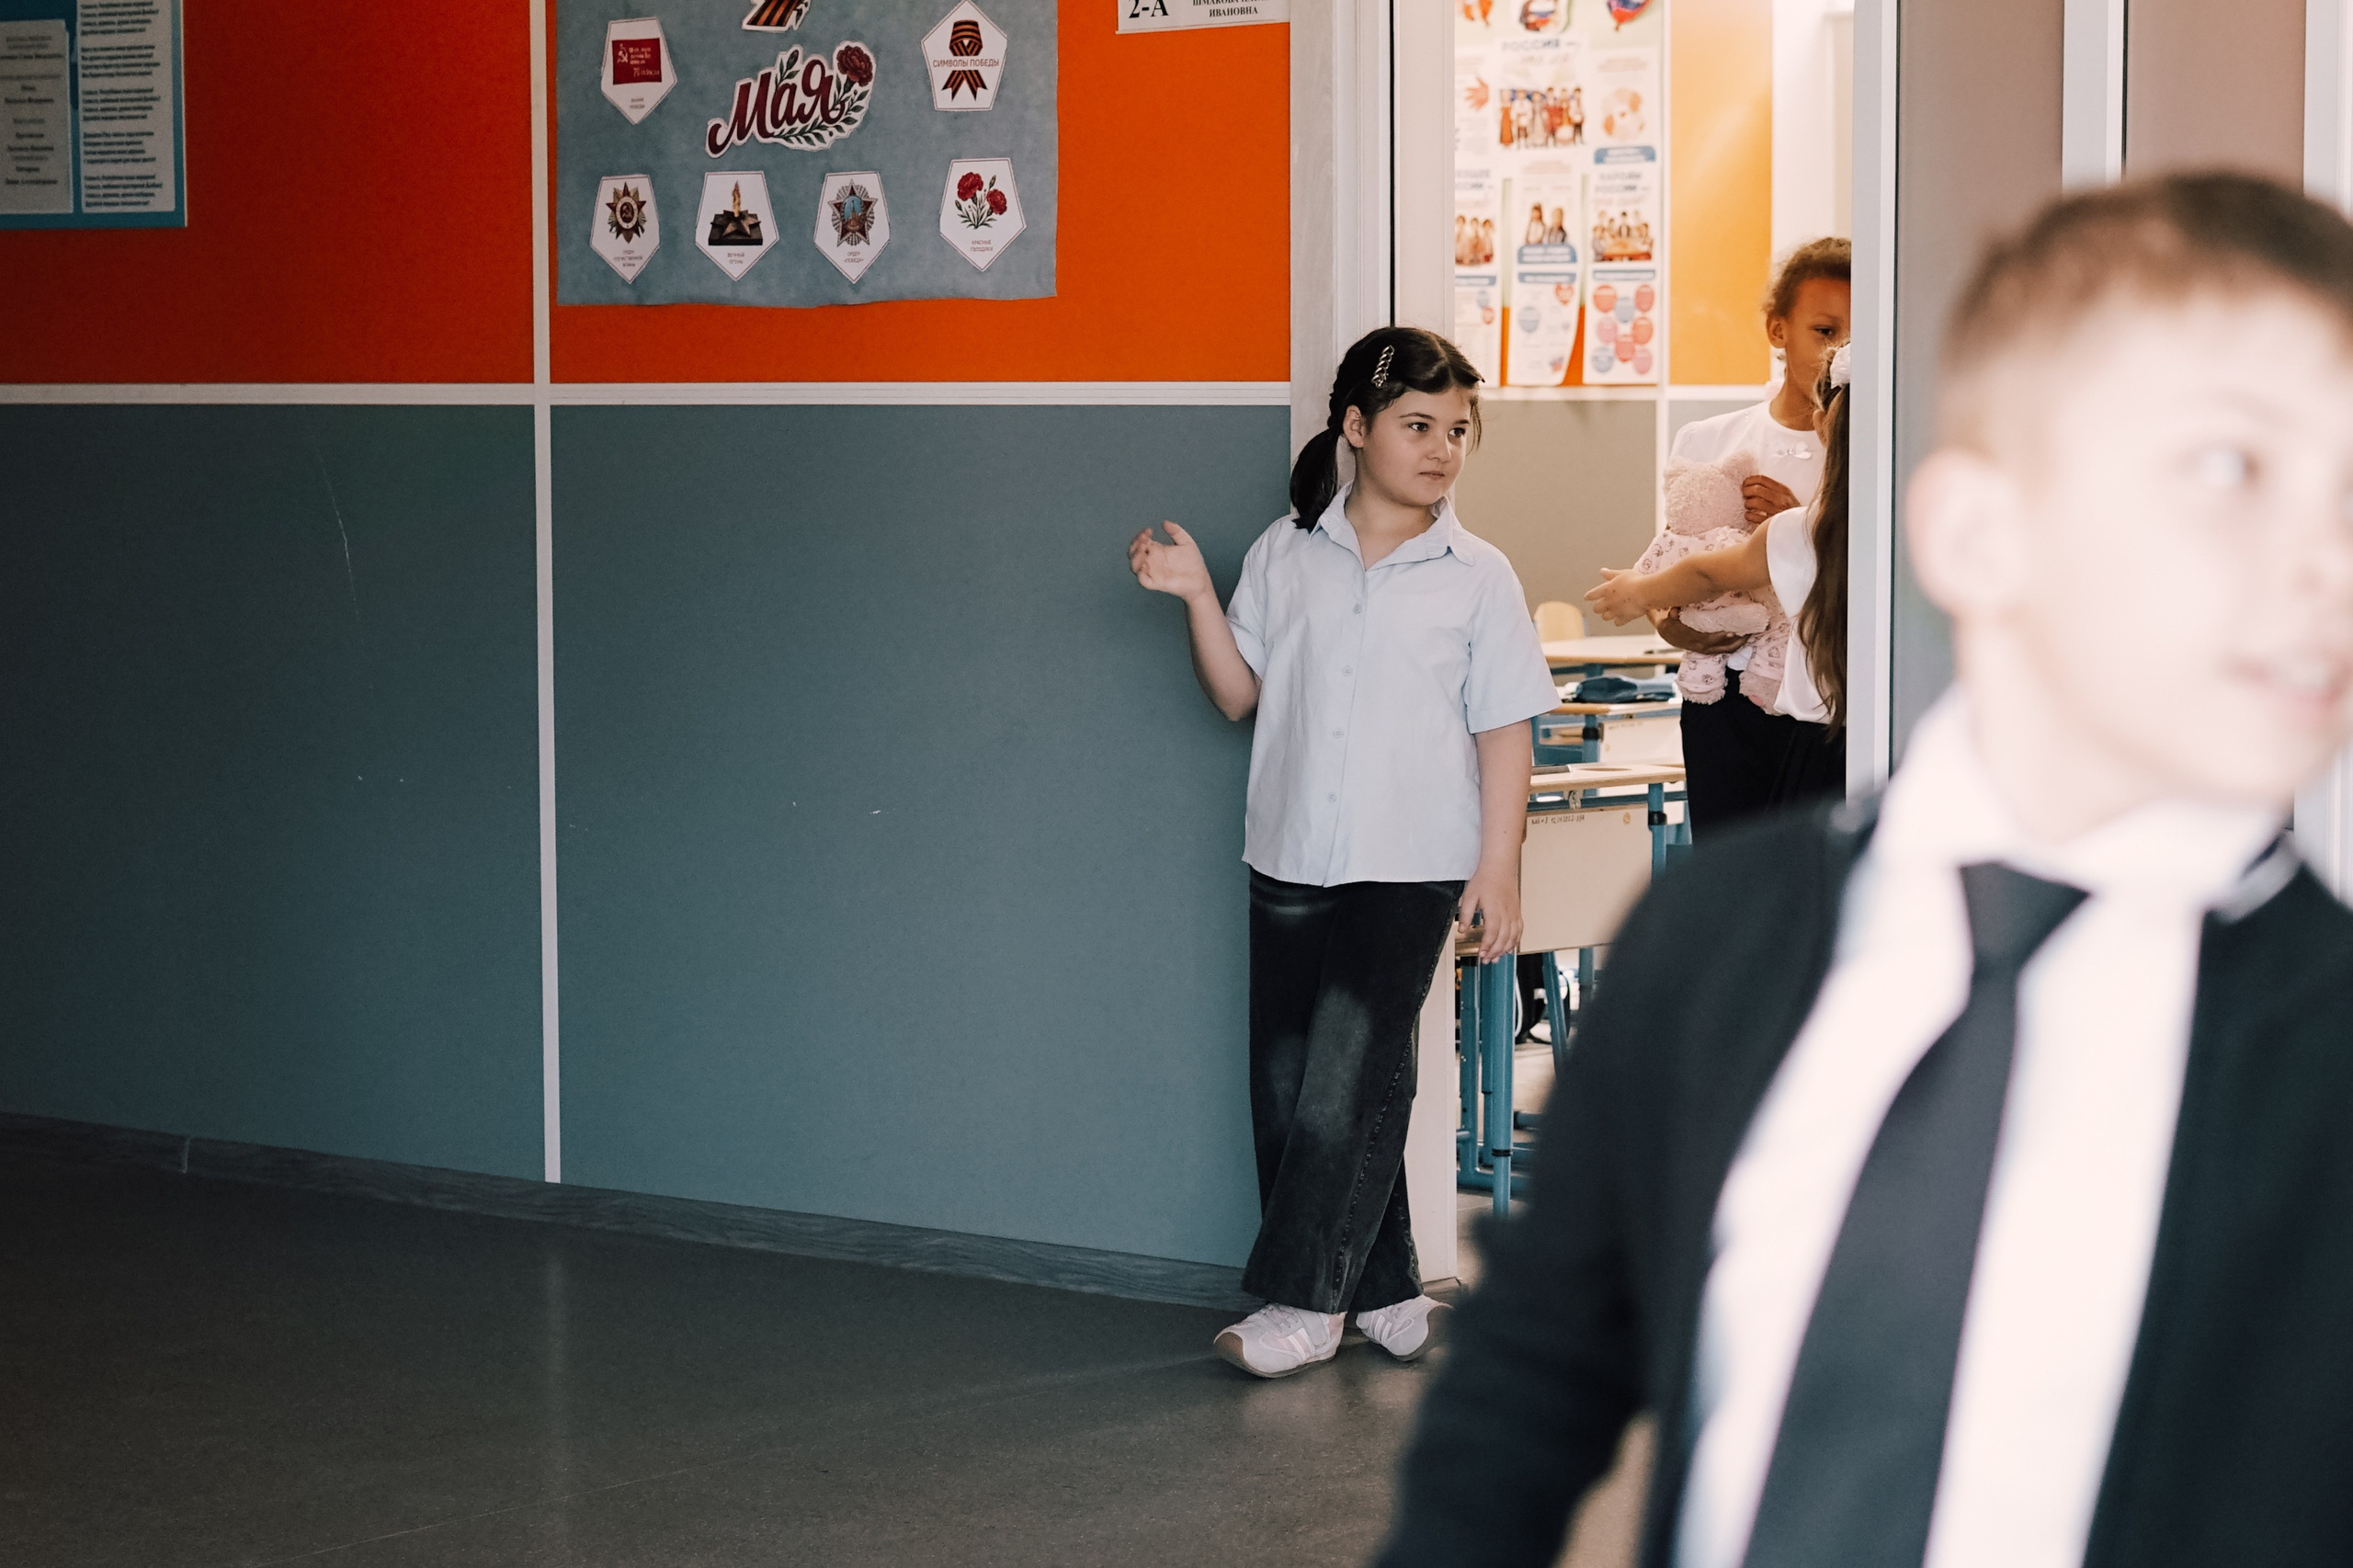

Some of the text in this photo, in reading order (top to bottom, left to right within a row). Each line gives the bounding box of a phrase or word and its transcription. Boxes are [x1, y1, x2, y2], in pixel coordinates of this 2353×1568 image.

[1209, 6, 1258, 17] ИВАНОВНА
[933, 58, 1000, 67] СИМВОЛЫ ПОБЕДЫ
[709, 59, 845, 154] Мая
